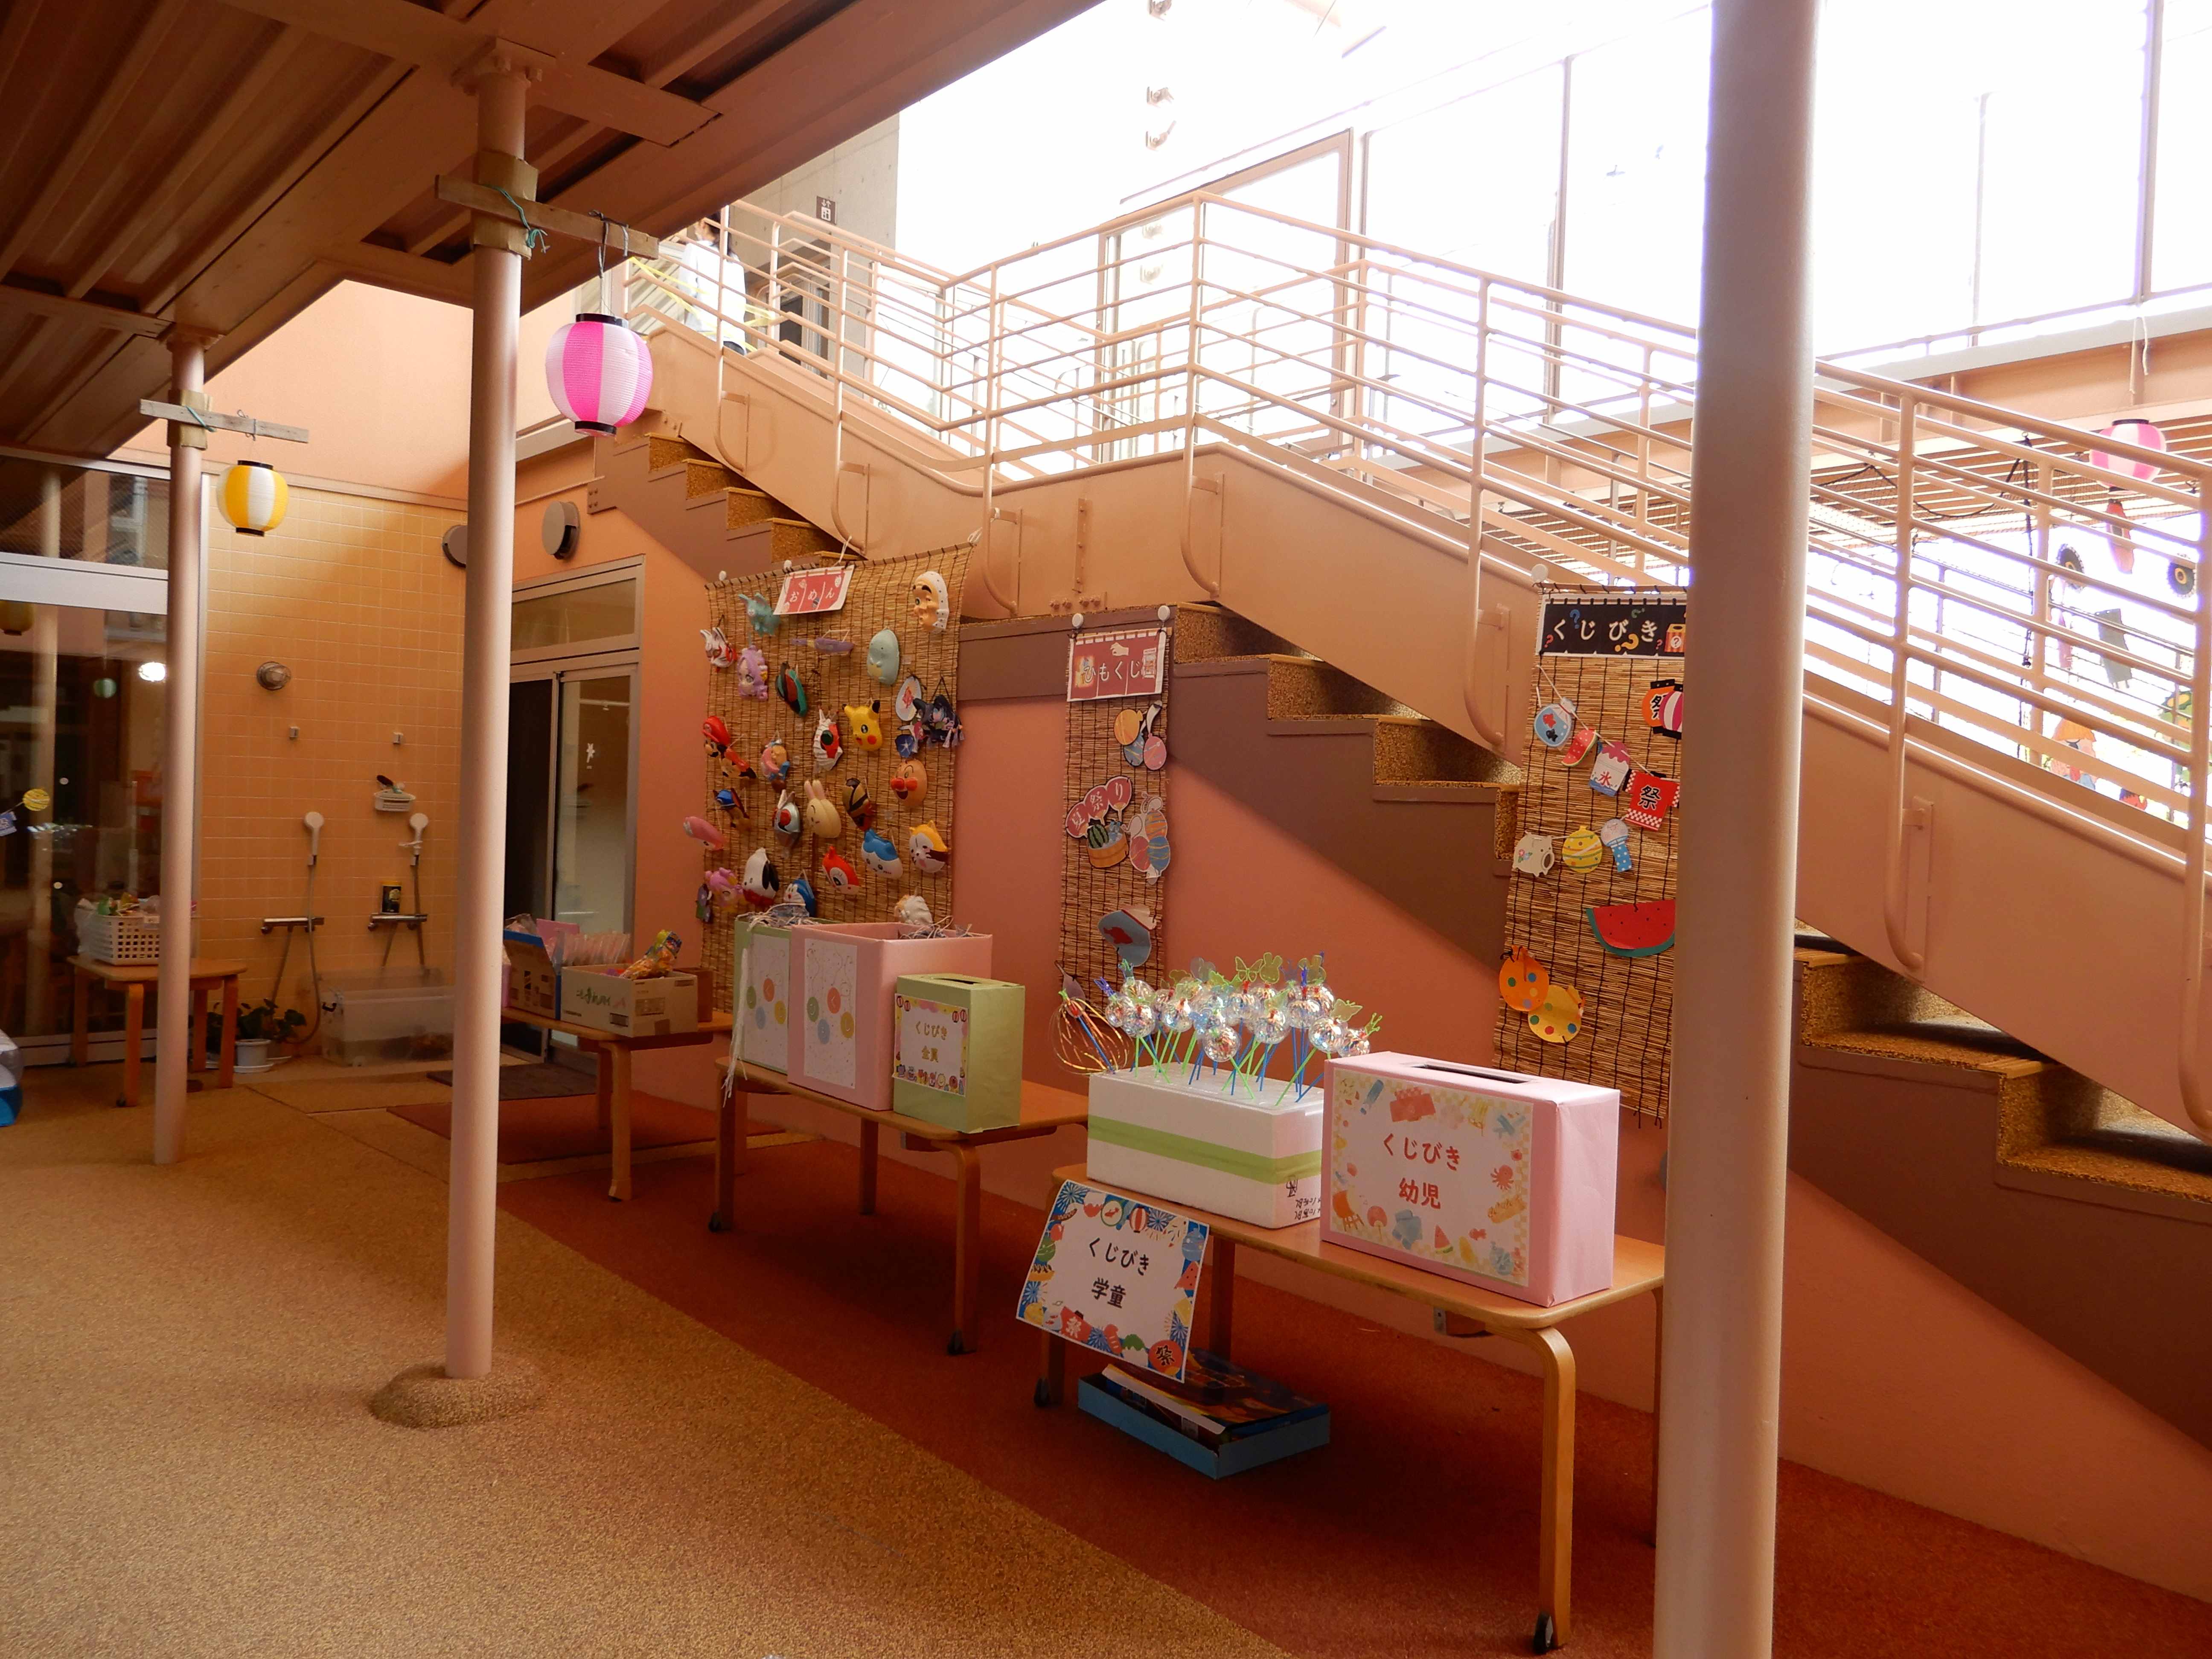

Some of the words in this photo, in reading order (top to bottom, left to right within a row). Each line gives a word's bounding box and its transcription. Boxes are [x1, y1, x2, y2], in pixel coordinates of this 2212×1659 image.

[789, 588, 835, 602] おめん
[1554, 618, 1658, 643] くじびき
[1084, 660, 1140, 683] ひもくじ
[1598, 771, 1612, 786] 氷
[1638, 784, 1662, 811] 祭
[916, 1021, 947, 1040] くじびき
[1383, 1133, 1460, 1171] くじびき
[1398, 1177, 1441, 1209] 幼児
[1088, 1237, 1150, 1276] くじびき
[1091, 1277, 1126, 1310] 学童
[1155, 1345, 1175, 1366] 祭
